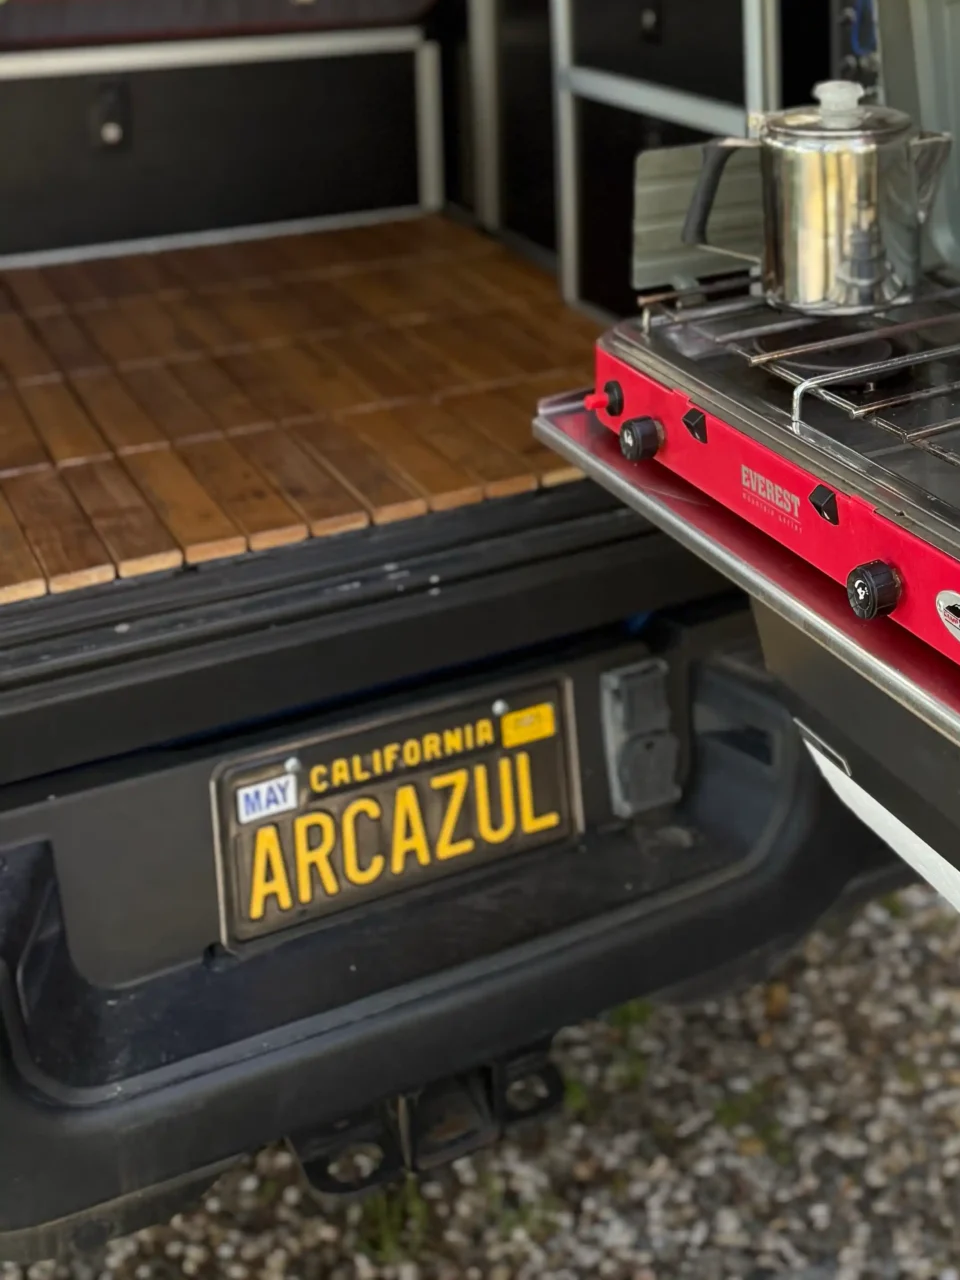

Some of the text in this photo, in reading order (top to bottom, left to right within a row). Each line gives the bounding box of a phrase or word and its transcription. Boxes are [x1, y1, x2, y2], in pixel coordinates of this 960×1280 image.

[741, 464, 801, 518] EVEREST
[309, 719, 494, 793] CALIFORNIA
[242, 778, 291, 817] MAY
[249, 752, 560, 920] ARCAZUL
